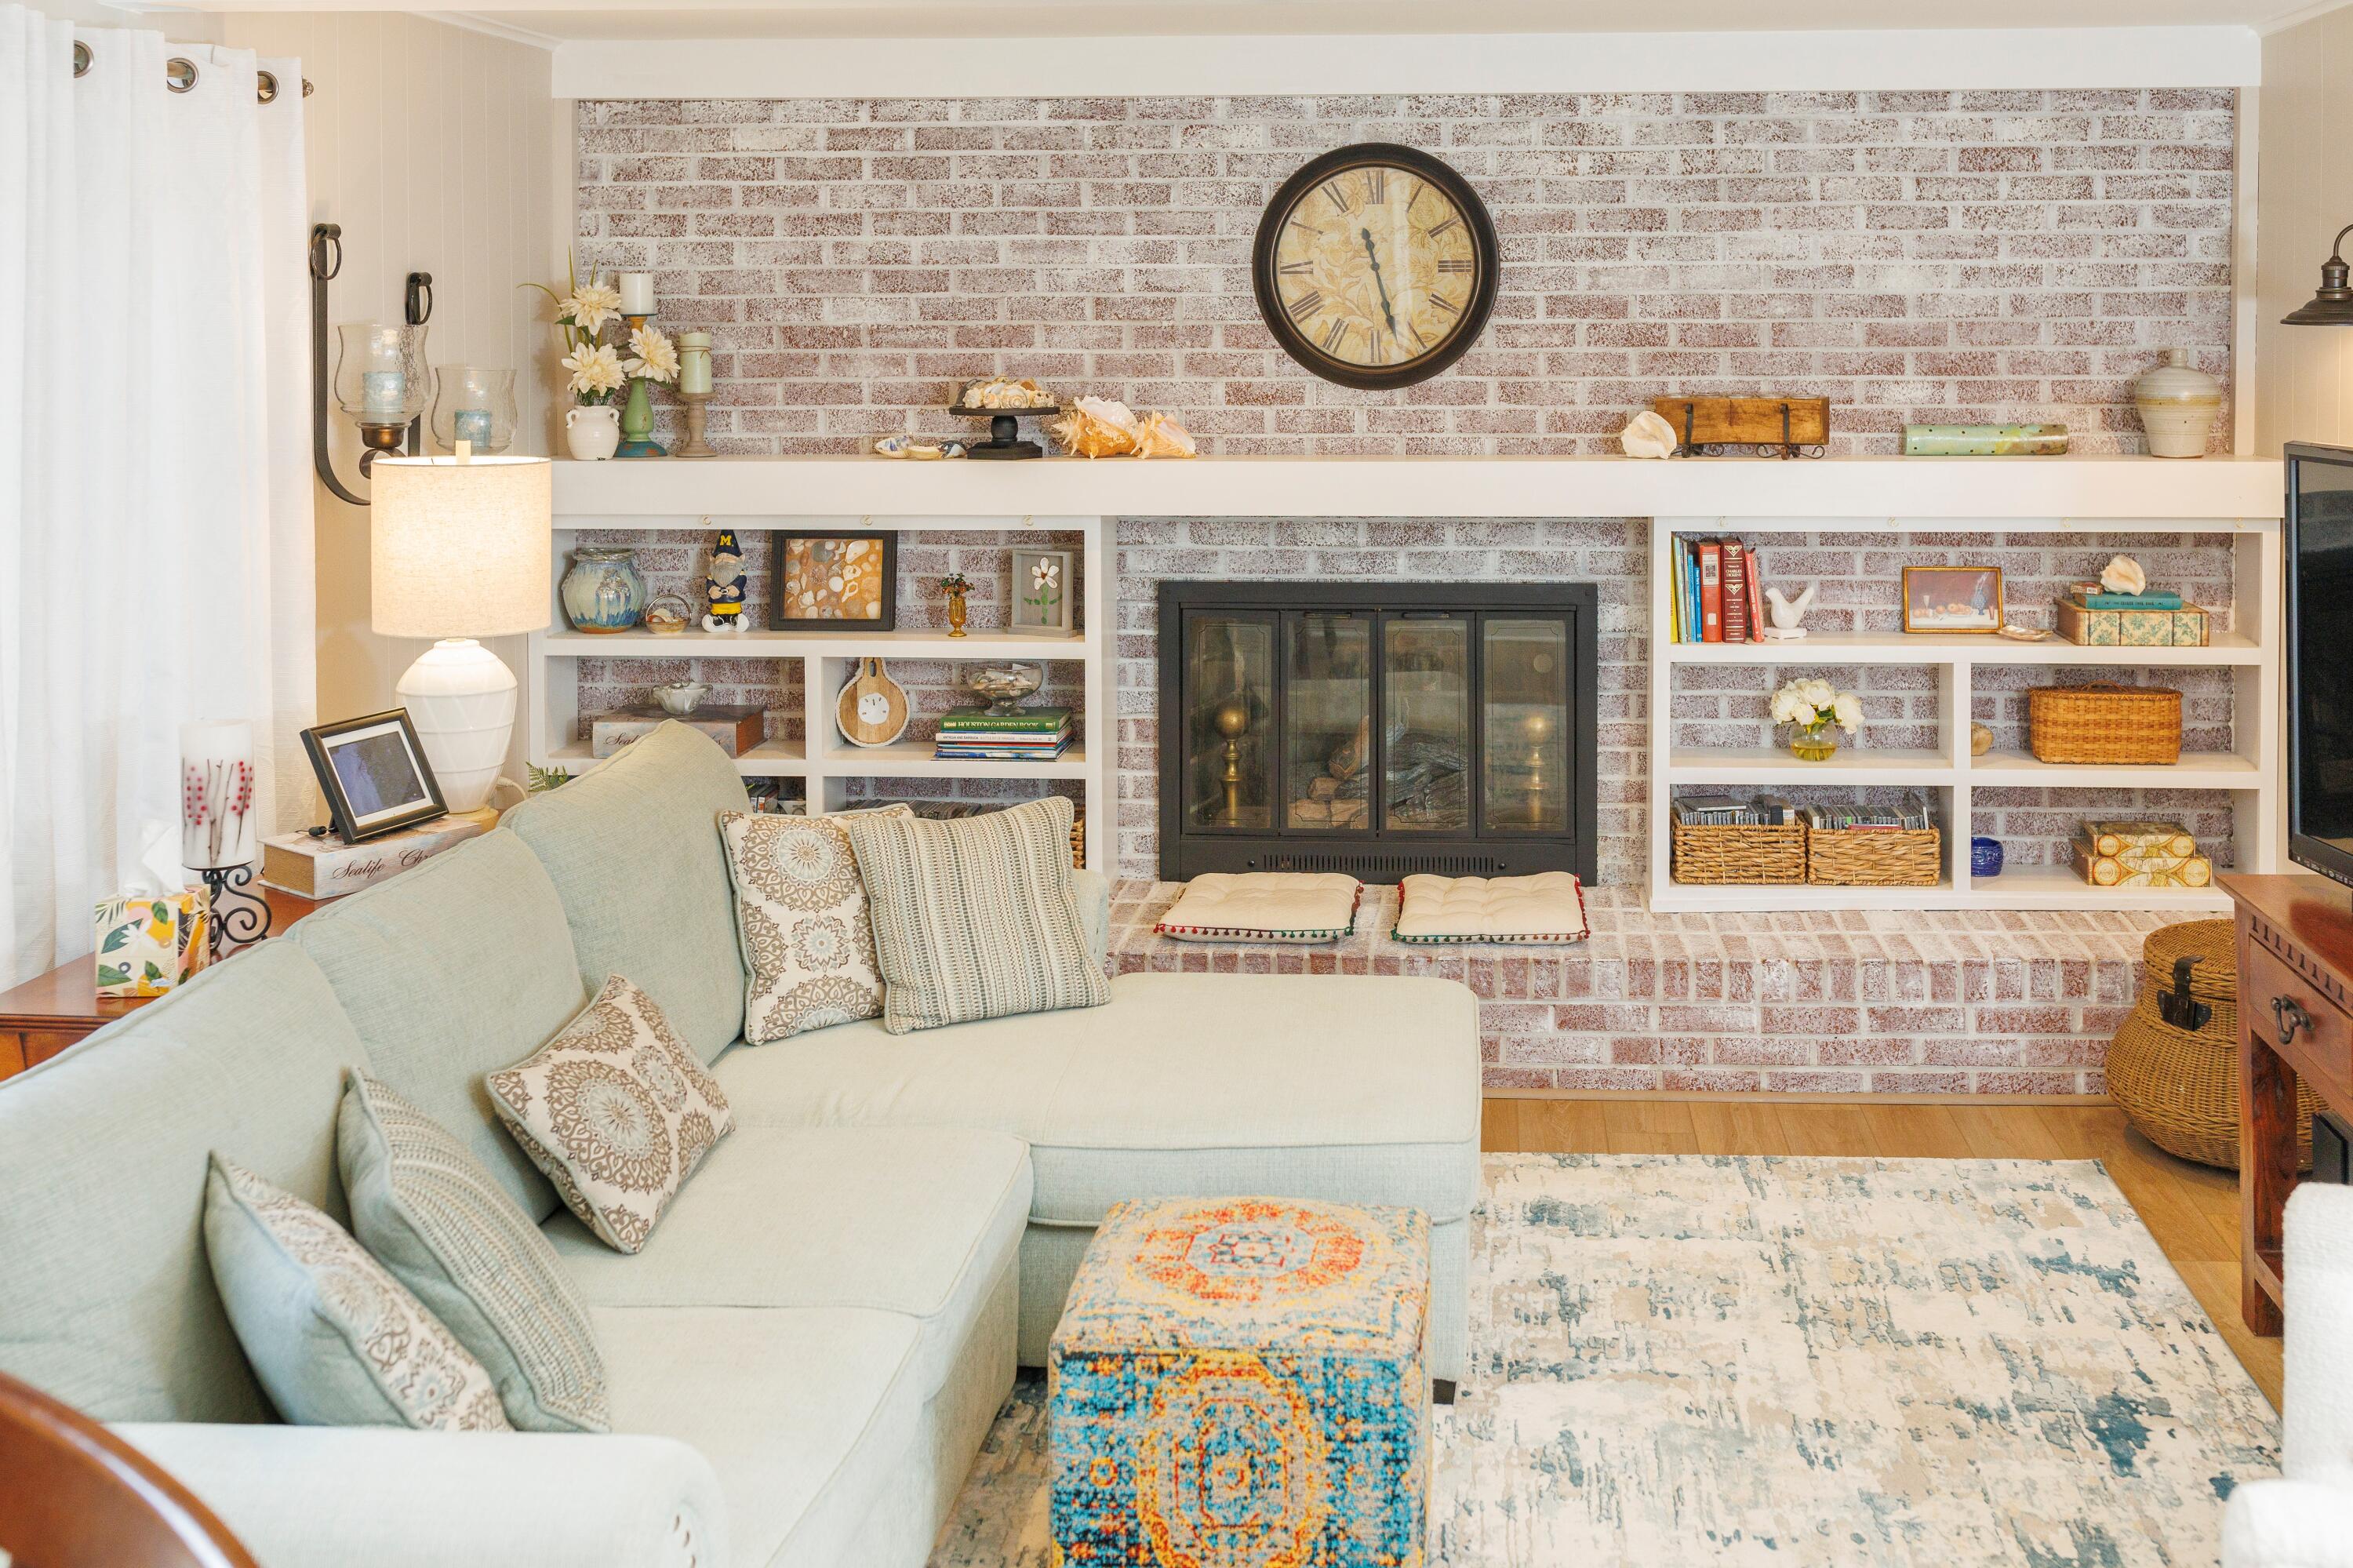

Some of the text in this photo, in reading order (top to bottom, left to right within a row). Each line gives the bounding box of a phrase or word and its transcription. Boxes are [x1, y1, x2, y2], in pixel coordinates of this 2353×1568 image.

[1438, 260, 1472, 273] III
[719, 535, 732, 546] M
[330, 858, 386, 879] Sealife
